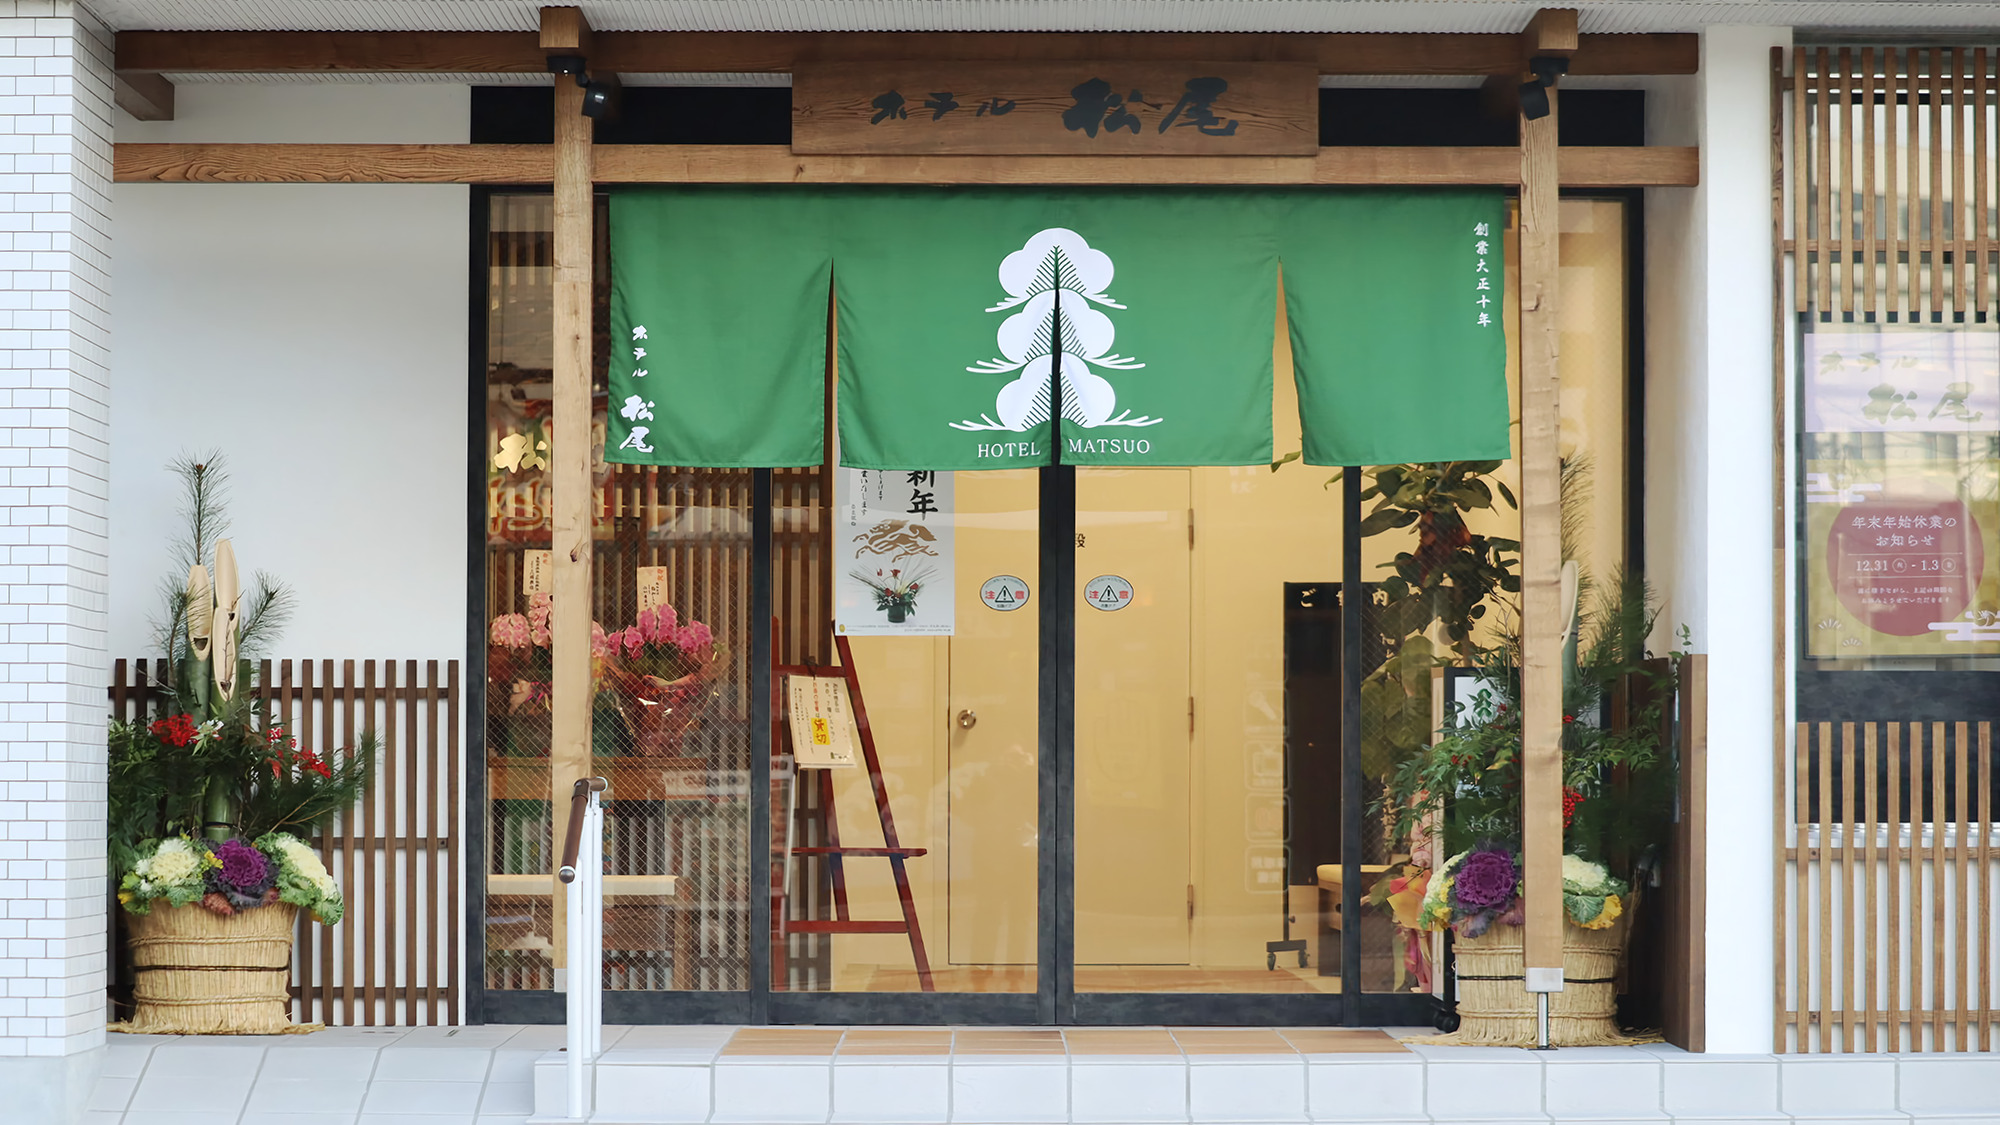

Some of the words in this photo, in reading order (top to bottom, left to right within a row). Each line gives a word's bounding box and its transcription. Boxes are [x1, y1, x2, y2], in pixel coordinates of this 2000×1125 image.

[871, 90, 1016, 125] ホテル
[1063, 77, 1239, 138] 松尾
[1473, 222, 1491, 327] 創業大正十年
[632, 325, 648, 377] ホテル
[619, 394, 655, 453] 松尾
[1862, 381, 1983, 425] 松尾
[977, 441, 1041, 458] HOTEL
[1068, 438, 1150, 454] MATSUO
[1852, 515, 1957, 529] 年末年始休業の
[1876, 533, 1935, 547] お知らせ
[1921, 560, 1939, 571] 1.3
